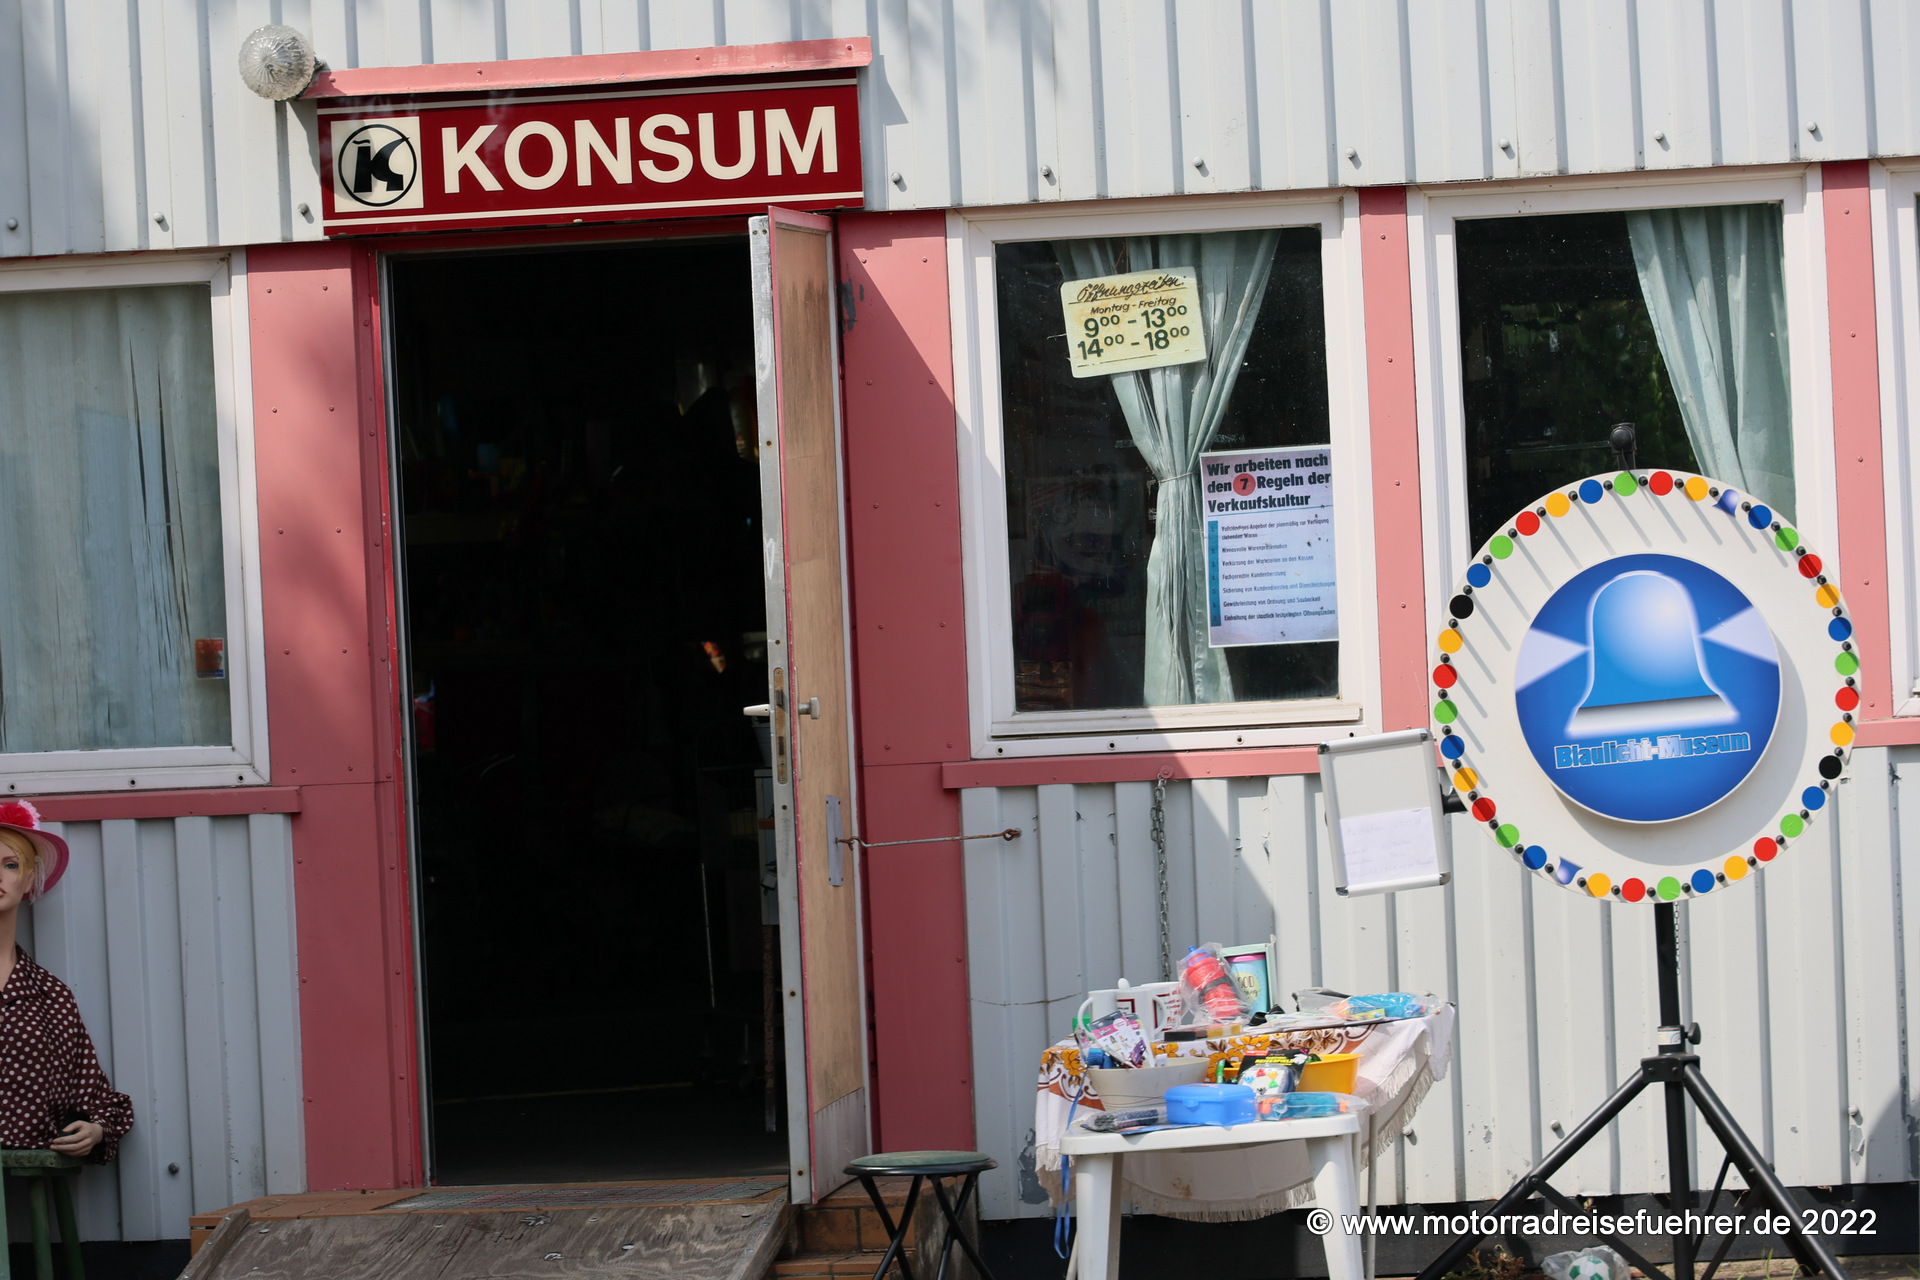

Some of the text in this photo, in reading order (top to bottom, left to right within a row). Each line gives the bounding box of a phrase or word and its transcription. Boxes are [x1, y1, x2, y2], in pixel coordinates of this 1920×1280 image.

[441, 106, 838, 194] KONSUM
[1090, 303, 1130, 315] Montag
[1138, 296, 1177, 309] Freitag
[1207, 454, 1328, 476] Wir arbeiten nach
[1207, 472, 1331, 493] den 7 Regeln der
[1207, 494, 1311, 513] Verkaufskultur
[1554, 731, 1751, 769] Blaulicht-Museum
